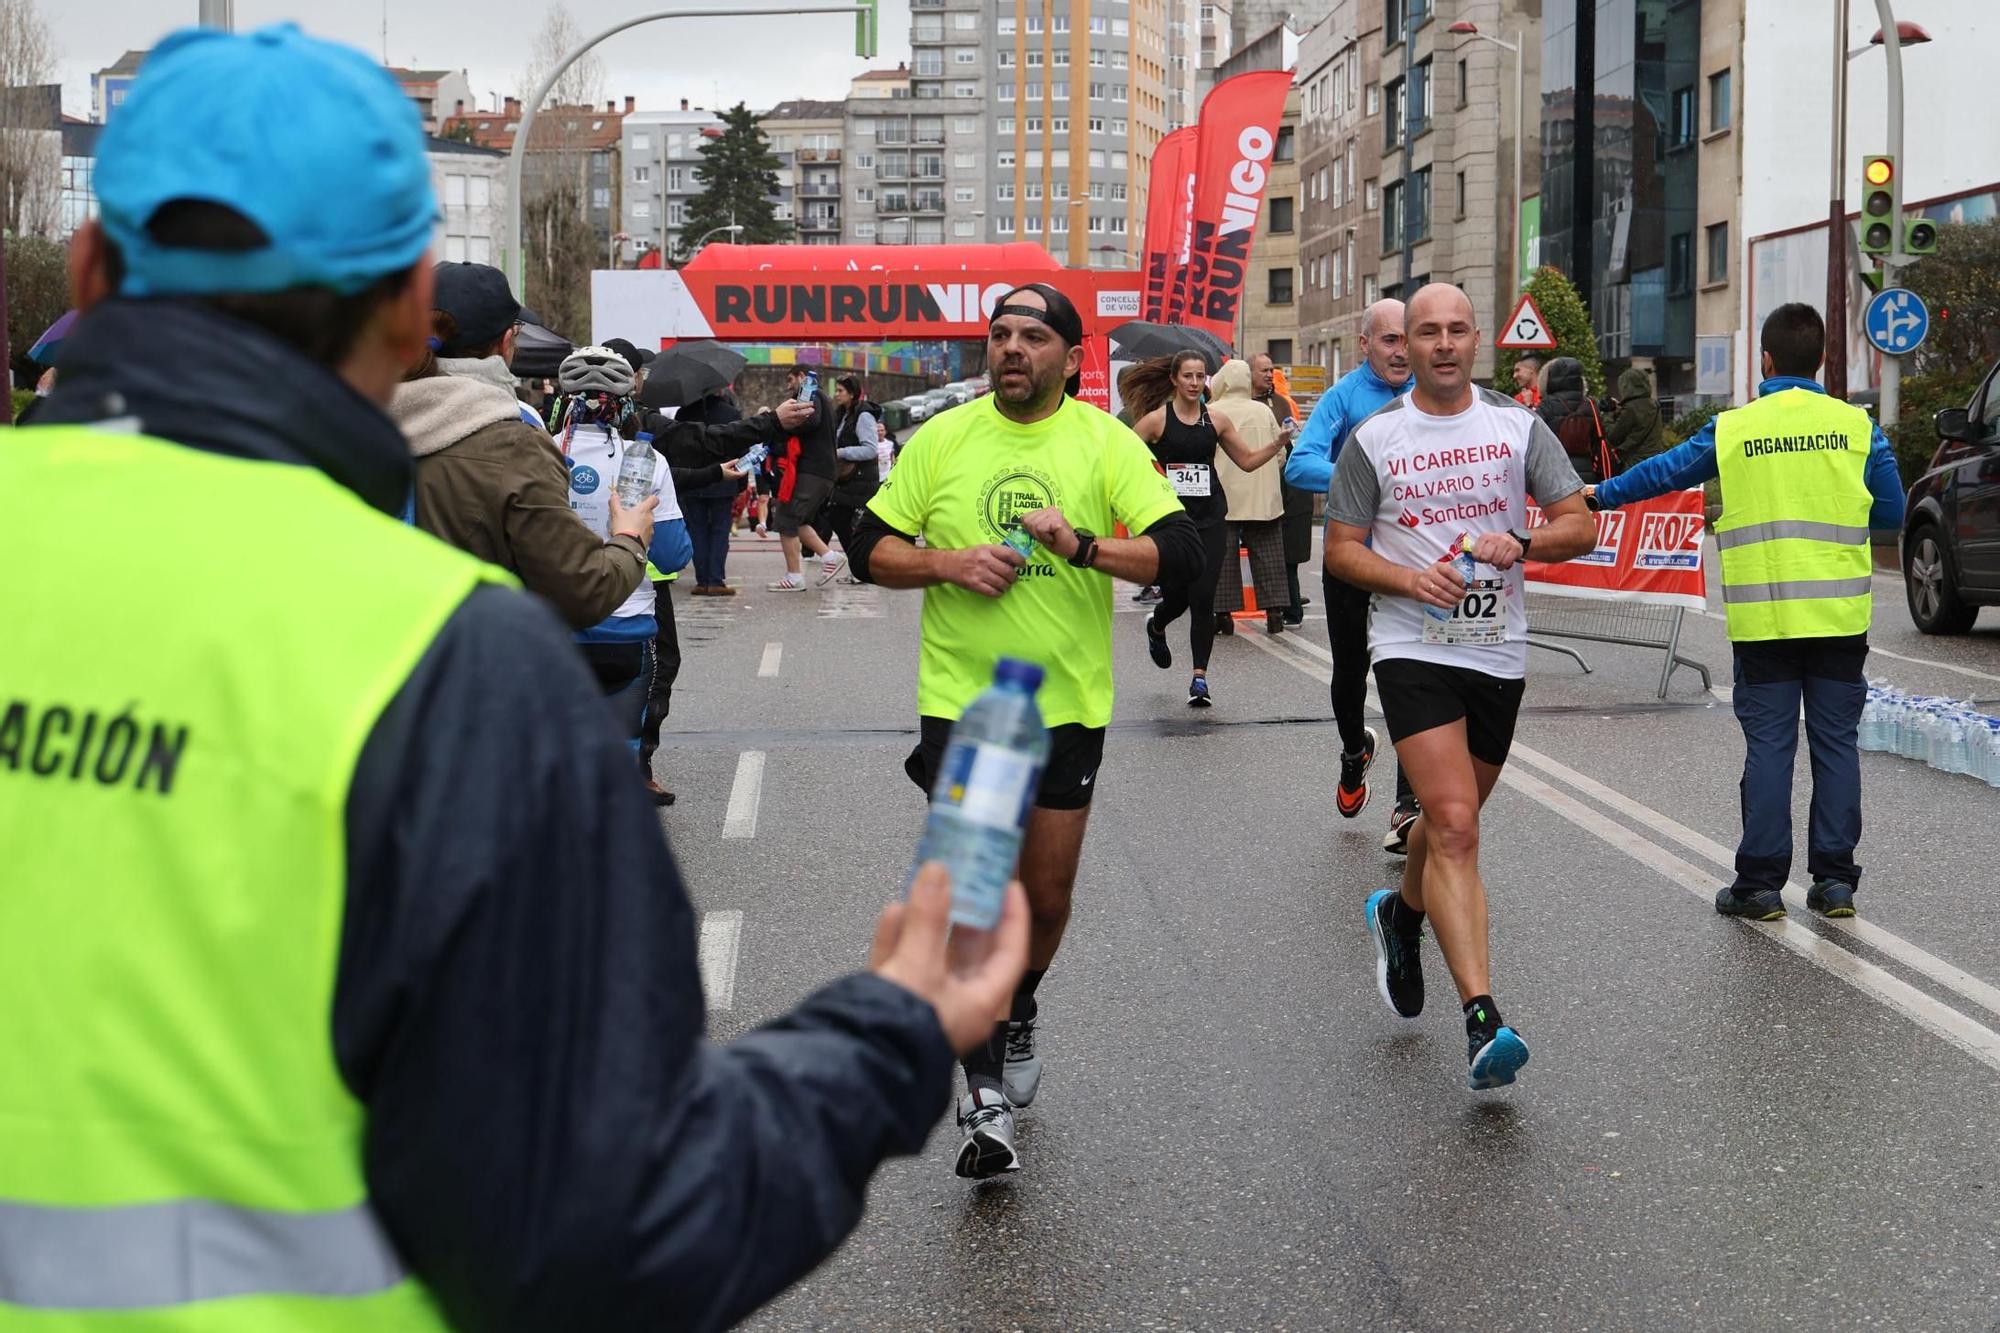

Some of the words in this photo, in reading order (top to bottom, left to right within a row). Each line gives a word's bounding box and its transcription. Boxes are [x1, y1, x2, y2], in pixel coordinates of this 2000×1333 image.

[714, 283, 1057, 323] RUNRUNVI
[1387, 458, 1407, 476] VI
[1413, 442, 1512, 471] CARREIRA
[1743, 430, 1849, 458] ORGANIZACIÓN
[1175, 470, 1201, 483] 341
[1393, 476, 1475, 501] CALVARIO
[1421, 497, 1508, 526] Santande
[1640, 515, 1704, 551] FROIZ
[0, 700, 190, 796] ACIÓN
